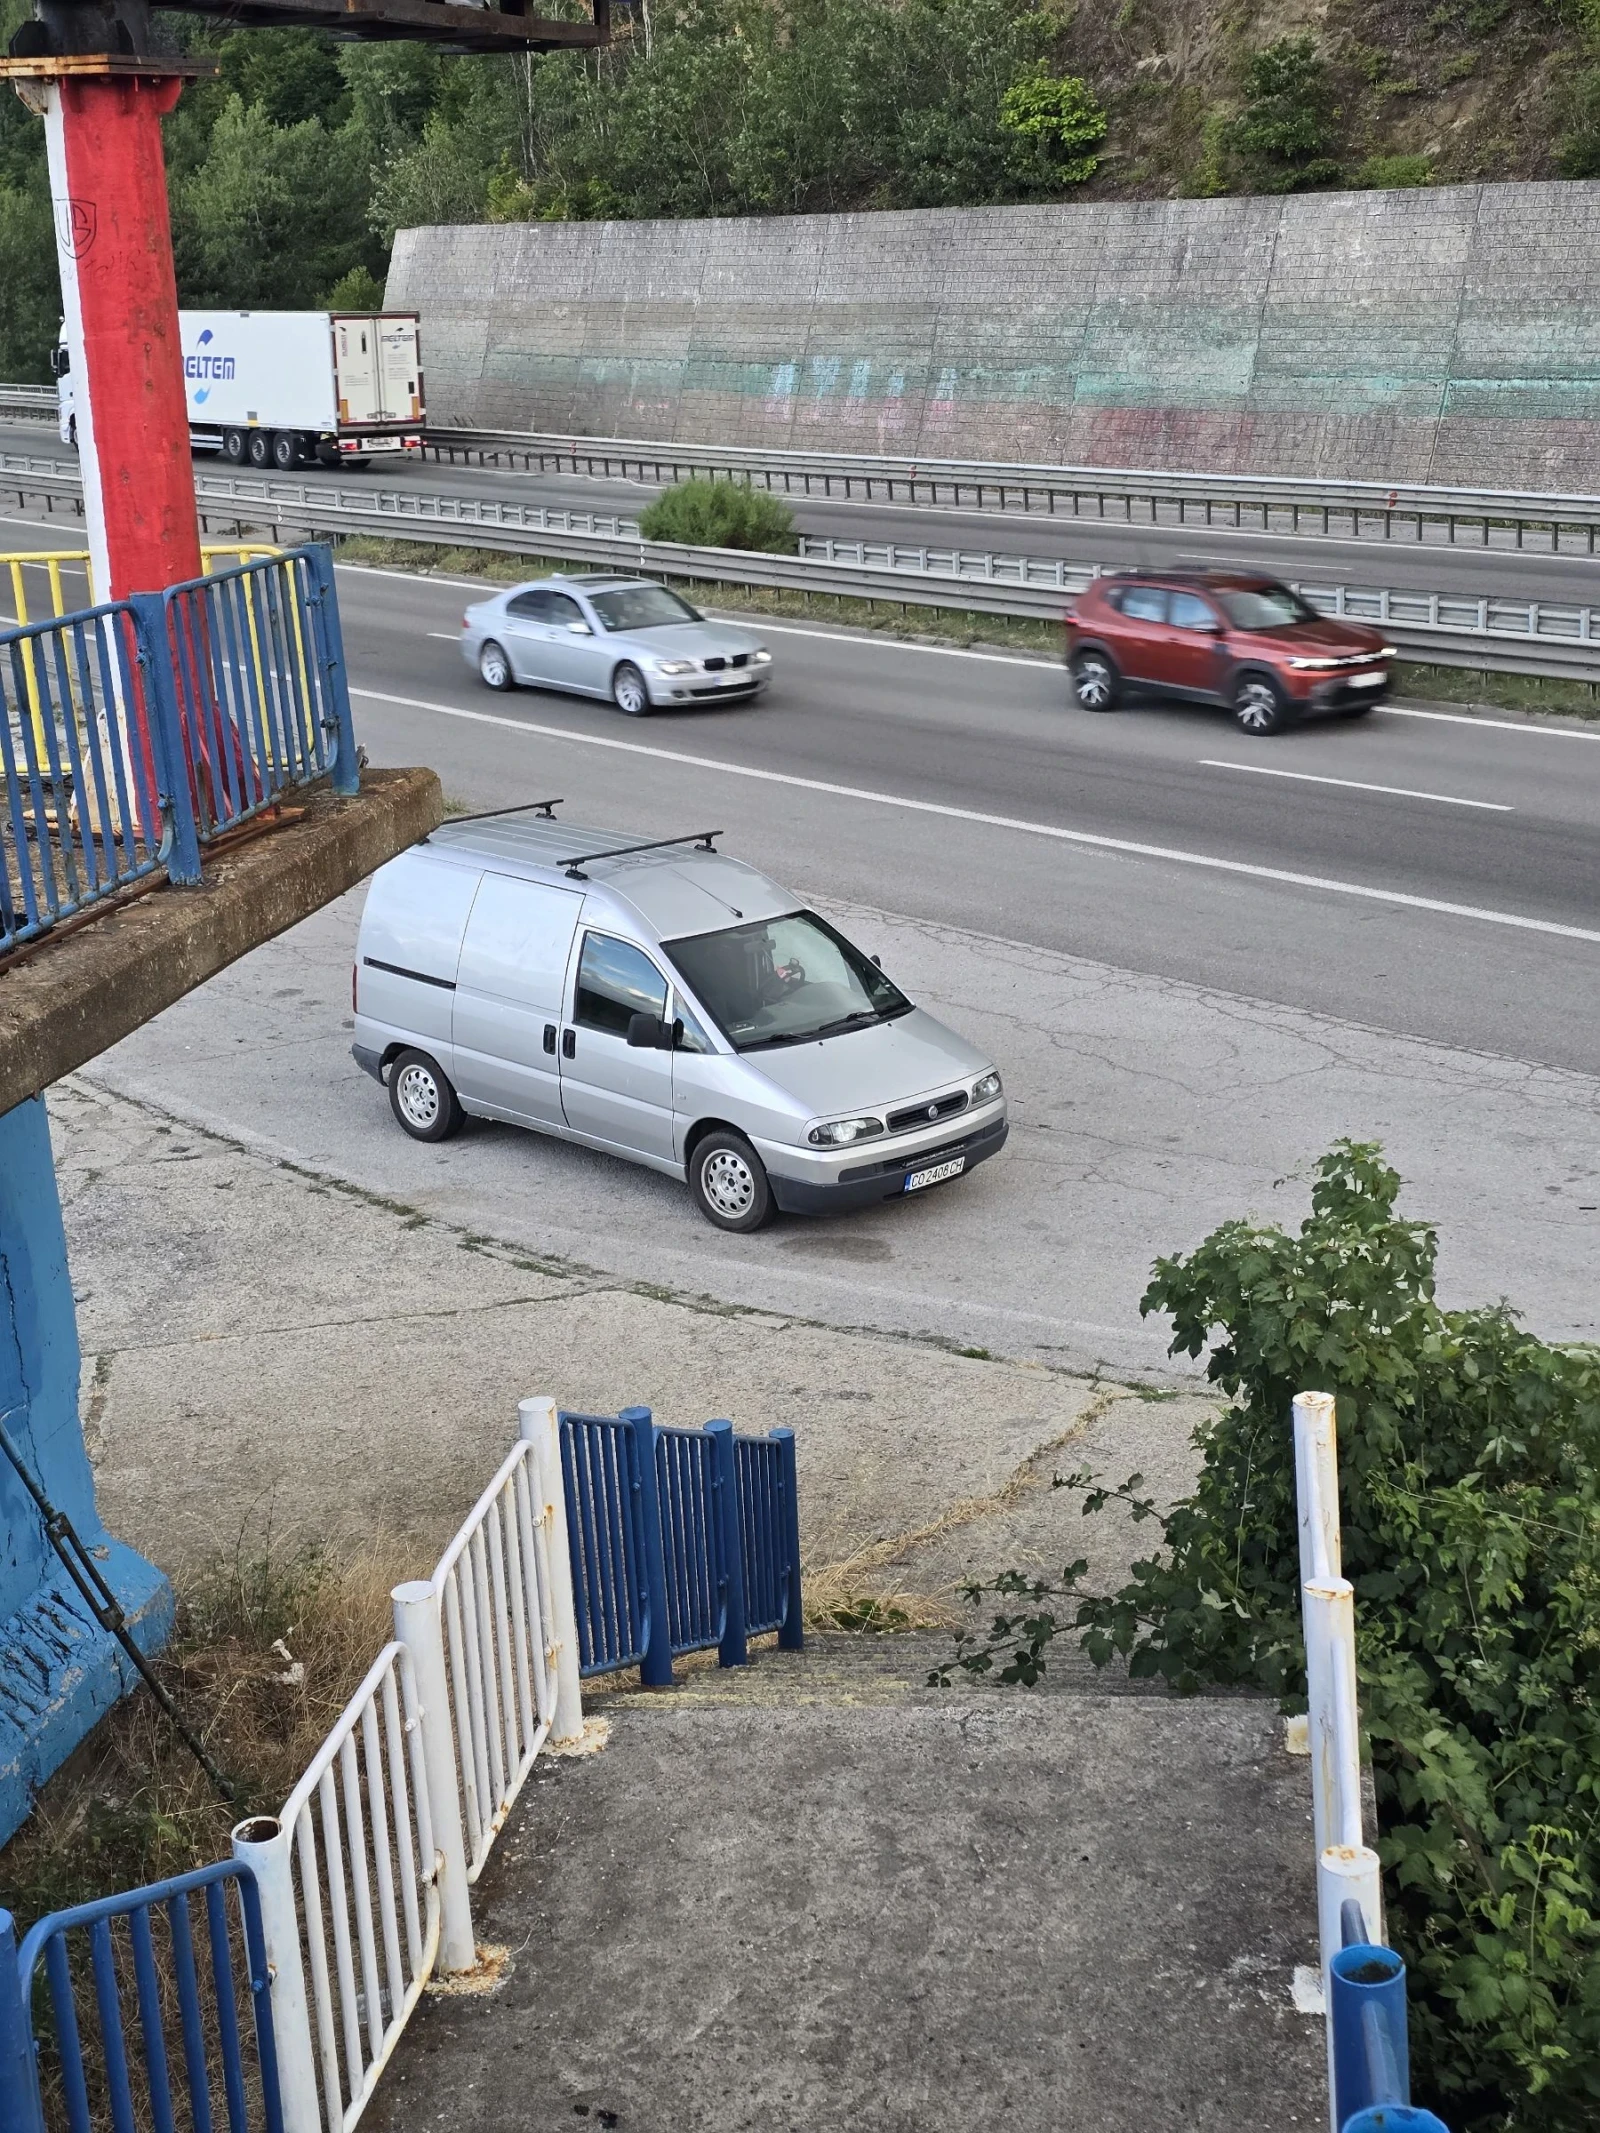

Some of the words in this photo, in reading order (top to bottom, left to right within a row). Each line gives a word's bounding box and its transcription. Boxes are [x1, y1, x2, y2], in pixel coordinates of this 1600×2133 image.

[182, 356, 235, 380] ELTEM
[911, 1173, 925, 1187] CO
[926, 1164, 949, 1183] 2408
[950, 1159, 963, 1174] CH
